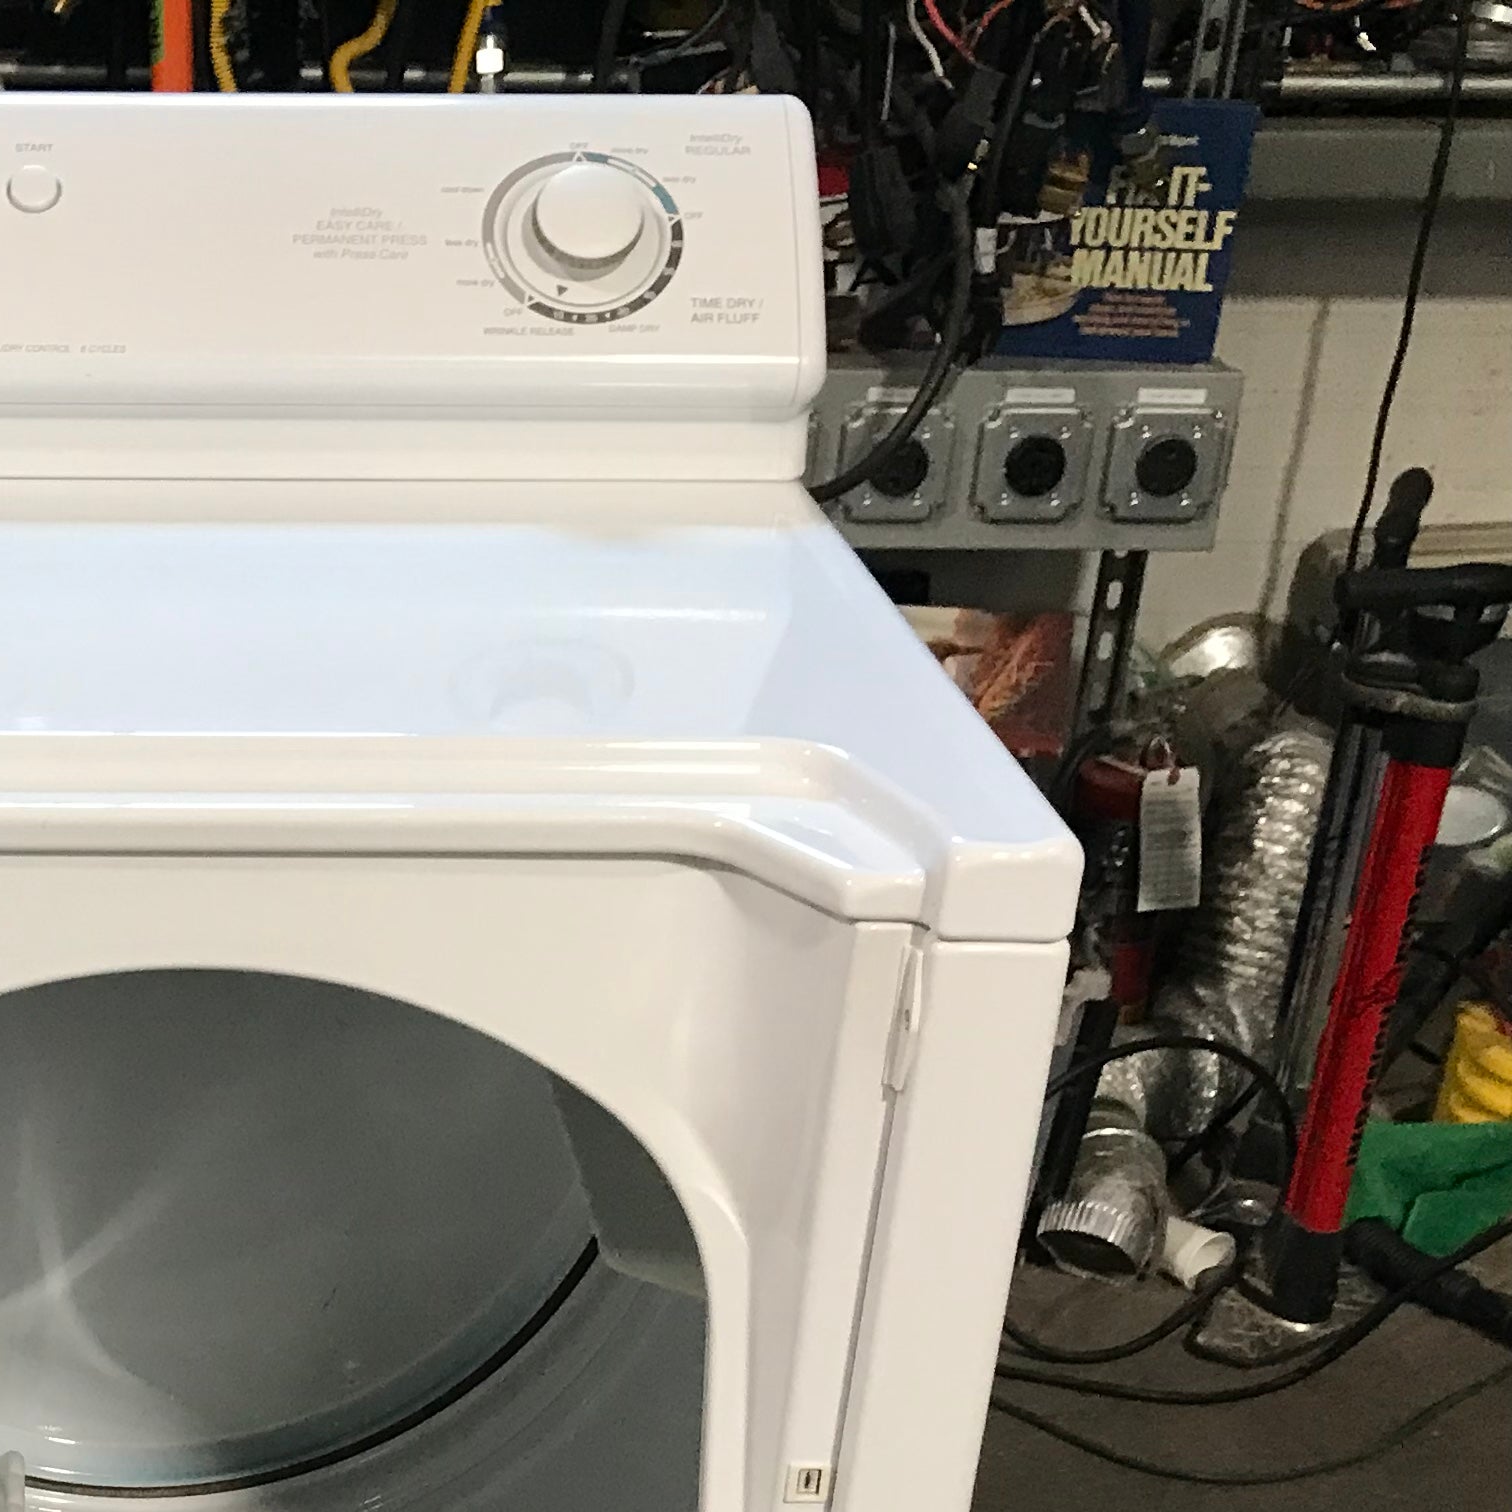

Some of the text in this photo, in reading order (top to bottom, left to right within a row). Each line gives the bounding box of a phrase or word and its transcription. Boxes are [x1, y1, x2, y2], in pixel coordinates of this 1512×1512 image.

[15, 143, 54, 152] START
[685, 145, 751, 156] REGULAR
[316, 220, 352, 231] EASY
[355, 220, 393, 231] CARE
[1070, 207, 1237, 250] YOURSELF
[292, 234, 428, 246] PERMANENT PRESS
[1070, 248, 1213, 292] MANUAL
[690, 297, 722, 309] TIME
[726, 297, 756, 309] DRY
[690, 312, 761, 324] AIR FLUFF
